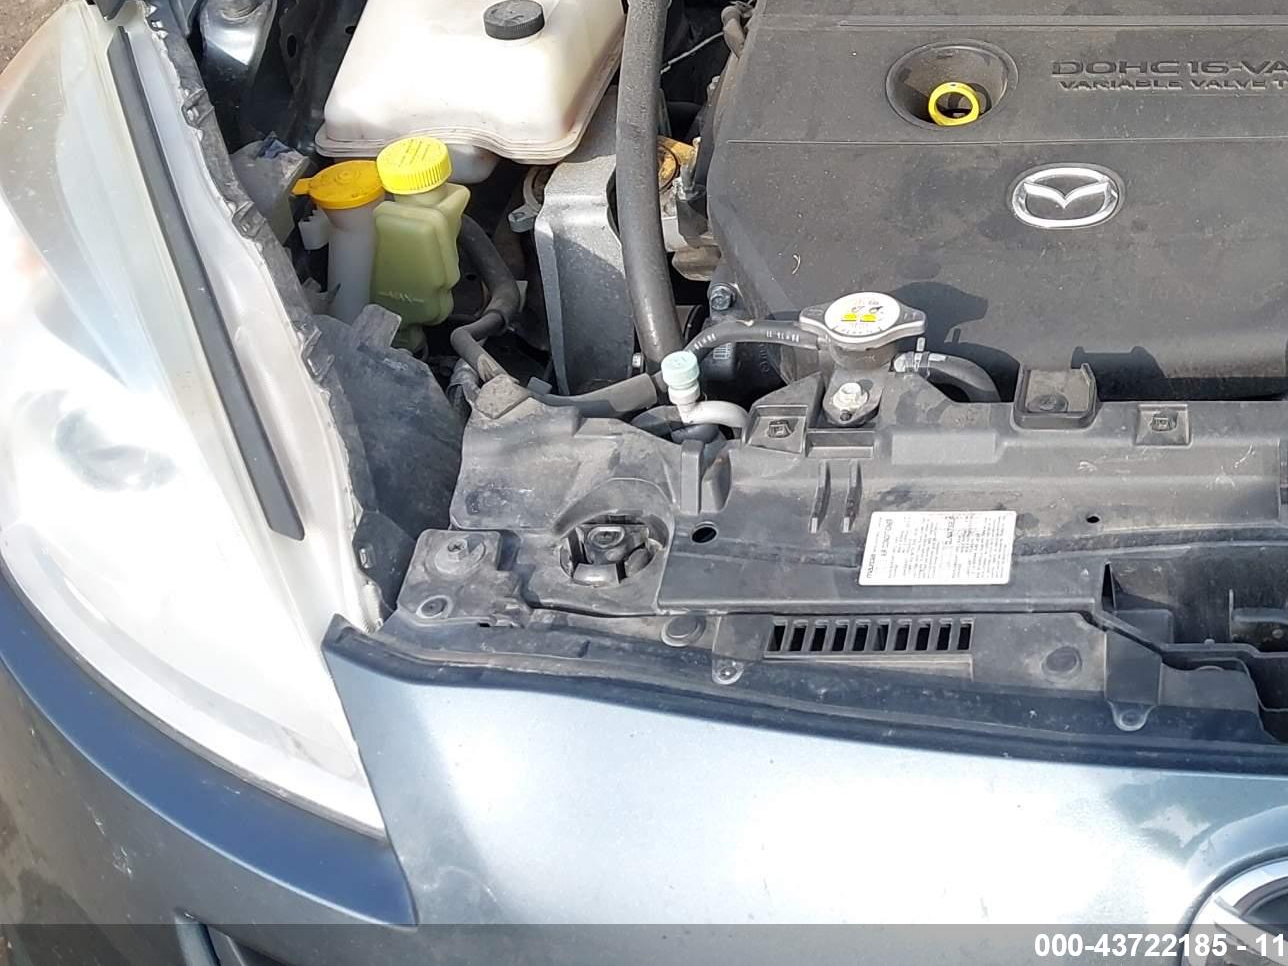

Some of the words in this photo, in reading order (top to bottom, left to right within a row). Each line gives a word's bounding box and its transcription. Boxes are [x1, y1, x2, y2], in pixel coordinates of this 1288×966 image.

[1051, 60, 1181, 75] DOHC
[1059, 80, 1184, 91] VARIABLE
[1190, 79, 1267, 90] VALVE
